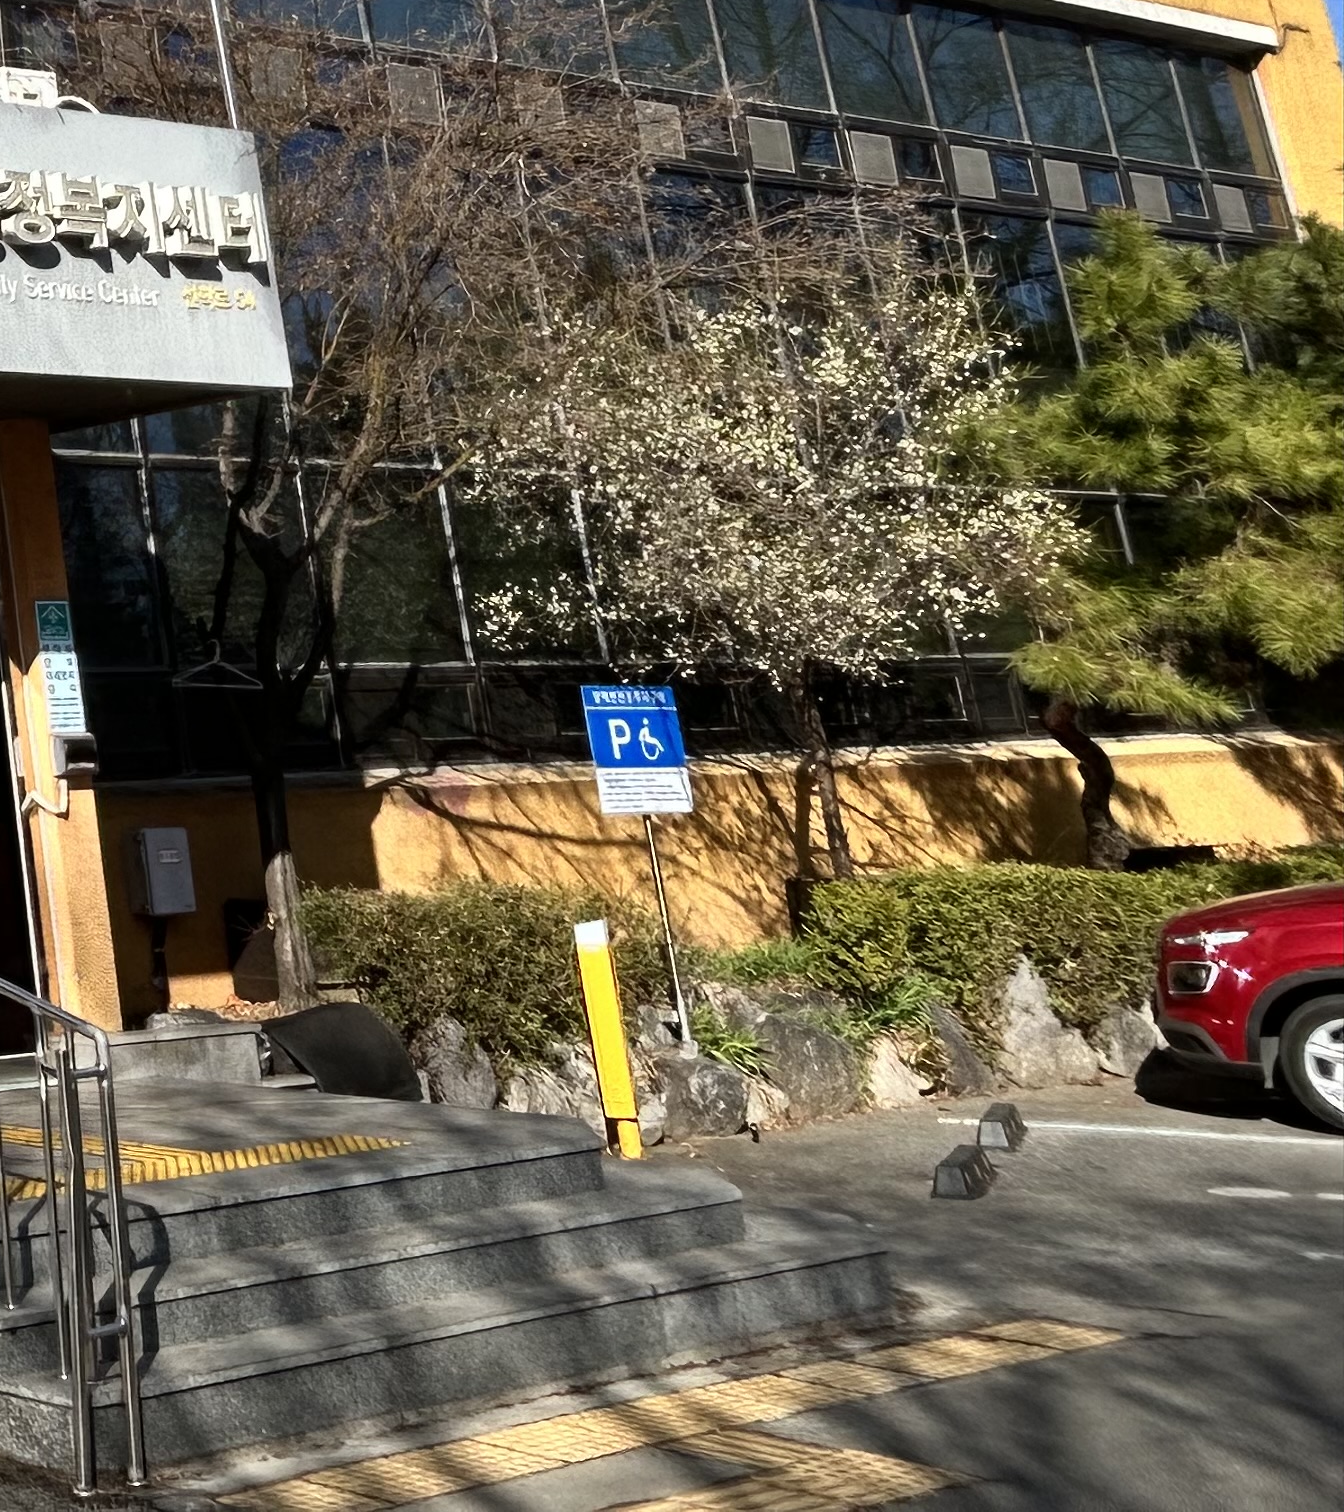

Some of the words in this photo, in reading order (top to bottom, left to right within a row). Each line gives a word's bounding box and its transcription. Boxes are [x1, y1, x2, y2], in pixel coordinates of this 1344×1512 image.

[22, 272, 95, 304] Service
[98, 278, 161, 307] Center
[608, 717, 631, 760] P
